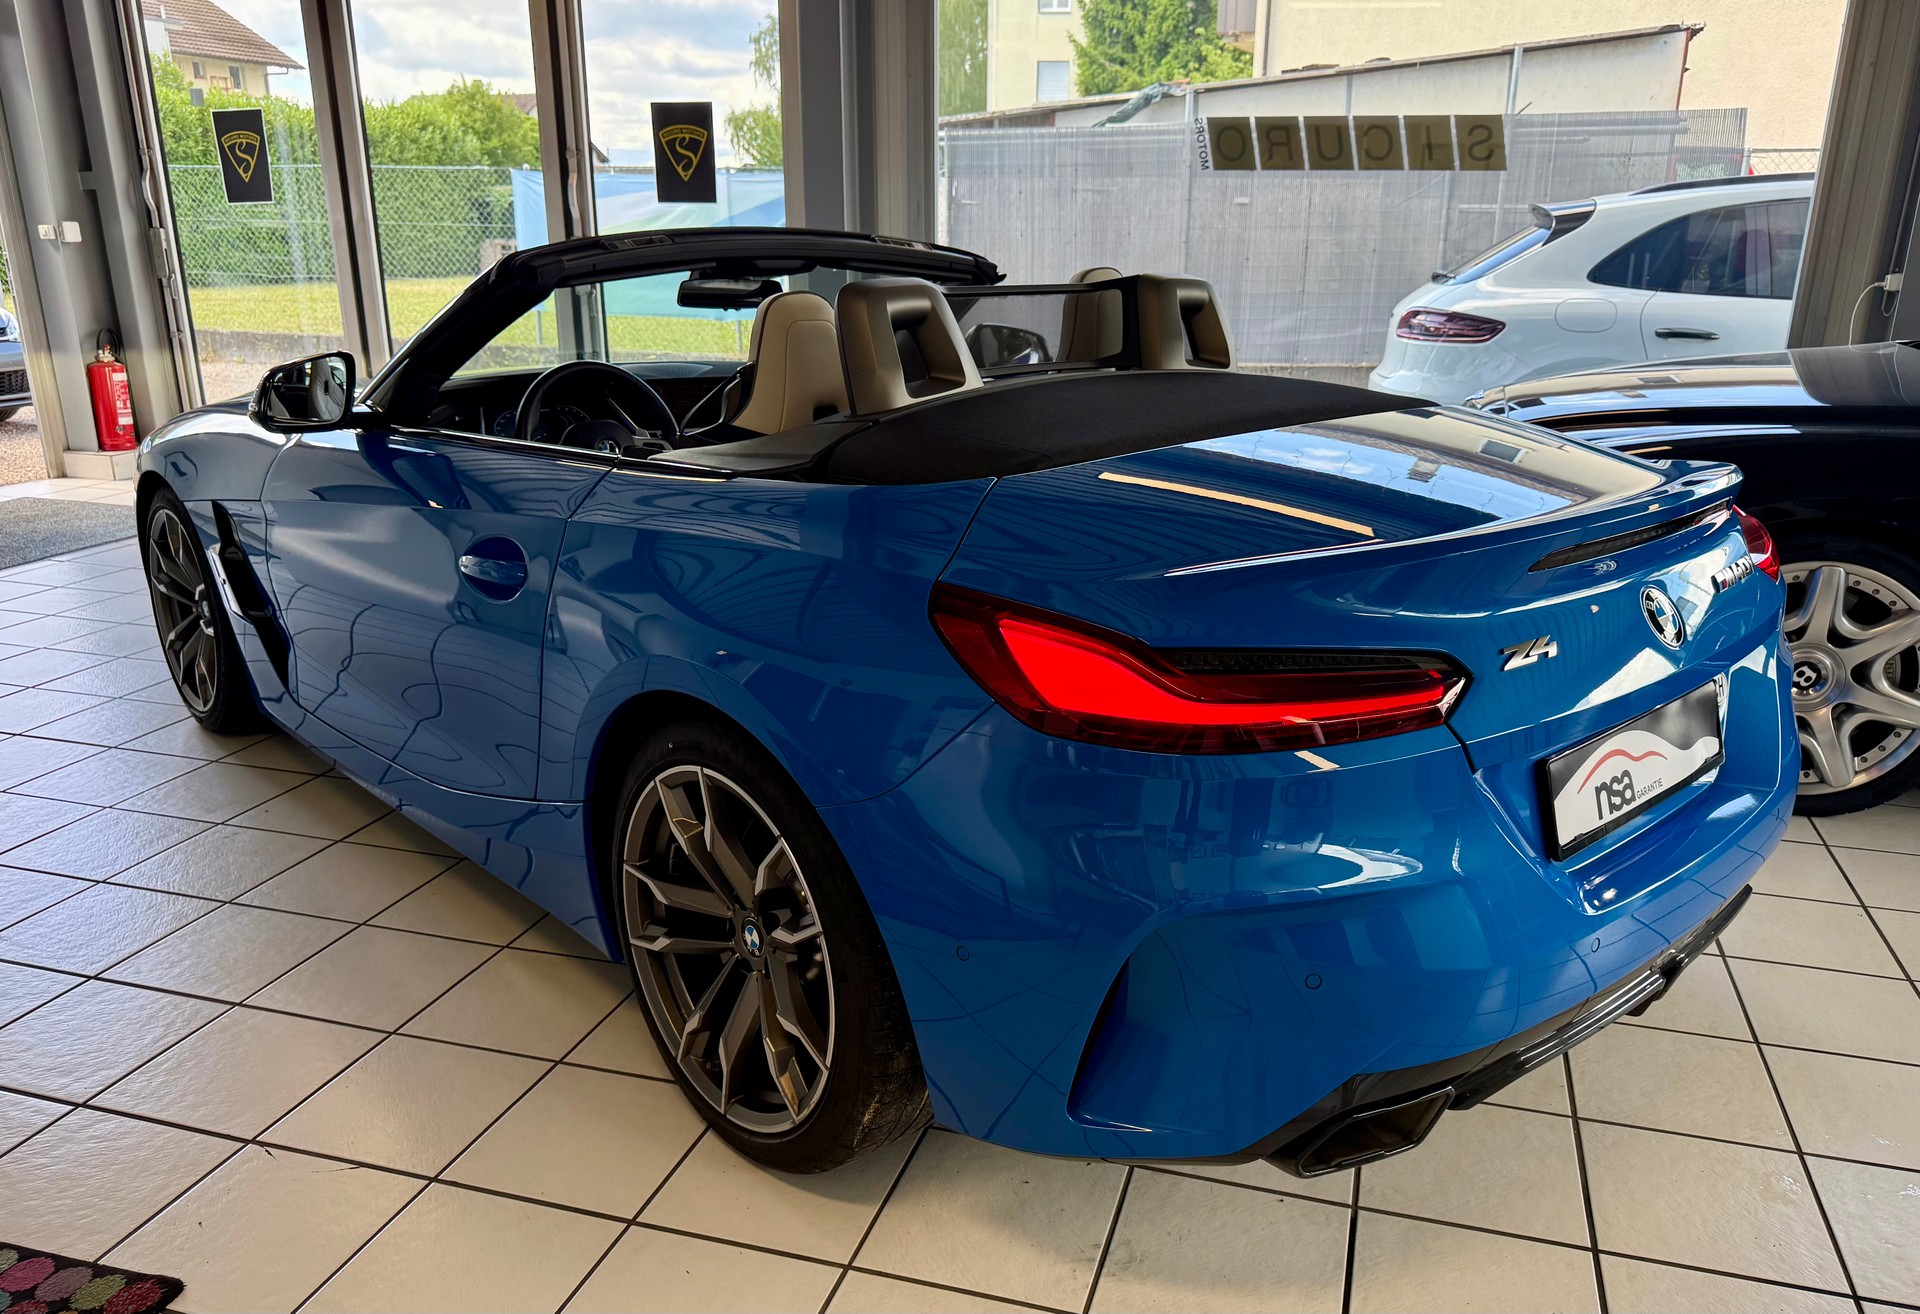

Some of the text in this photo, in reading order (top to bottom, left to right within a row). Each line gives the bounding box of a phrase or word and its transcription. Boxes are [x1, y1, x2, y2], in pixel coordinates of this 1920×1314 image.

[1500, 635, 1557, 672] Z4
[1594, 769, 1664, 820] nsa GARANTIE
